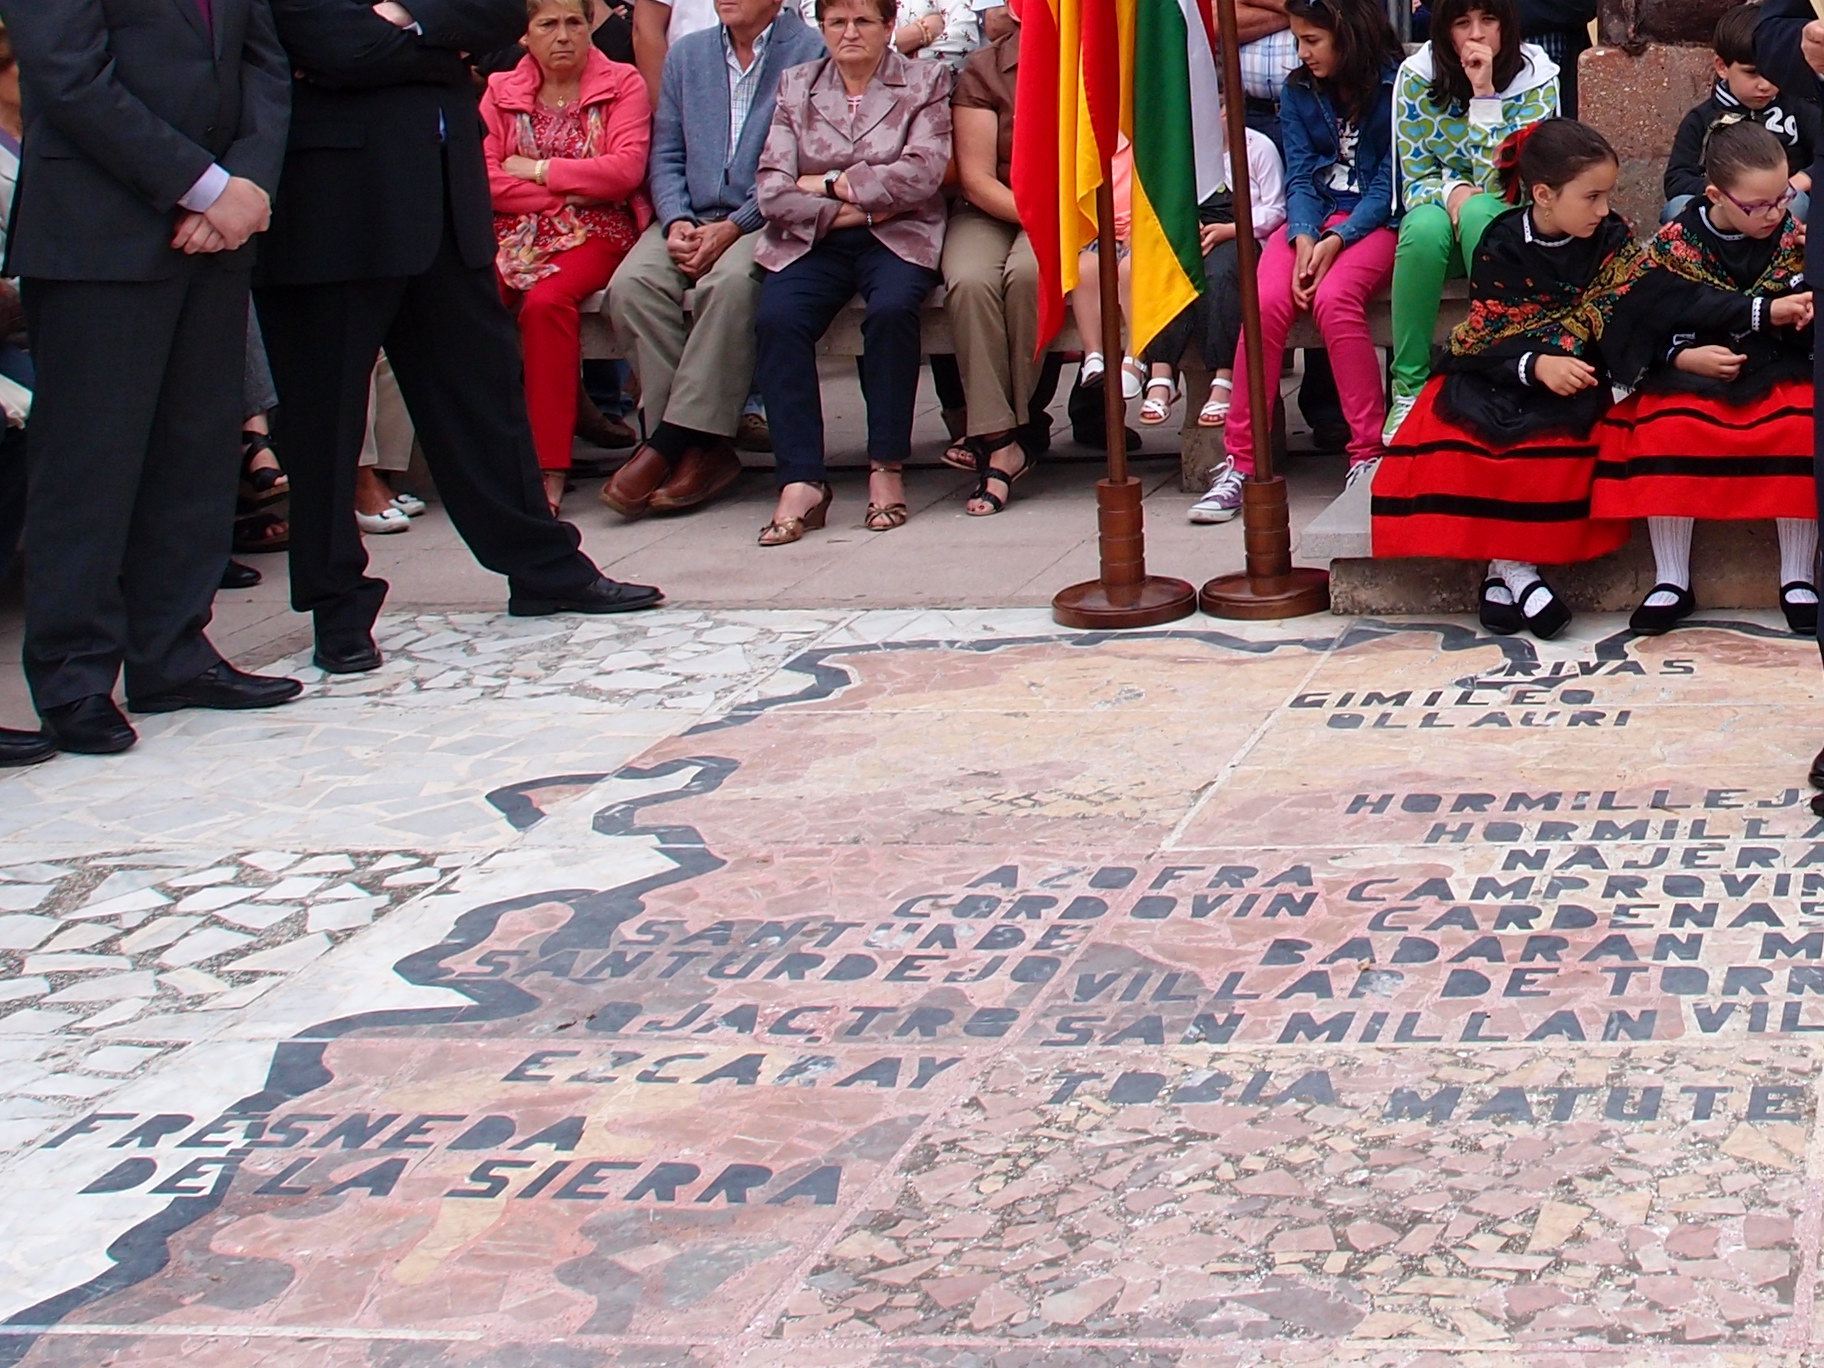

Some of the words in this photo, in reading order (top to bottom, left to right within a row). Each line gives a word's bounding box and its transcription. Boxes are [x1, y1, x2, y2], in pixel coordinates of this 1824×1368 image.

[1763, 106, 1799, 146] 29
[1502, 659, 1696, 677] RIVAS
[1289, 688, 1595, 708] GIMILEO
[1325, 710, 1633, 729] OLLAURI
[1346, 787, 1801, 815] HORMILLEJ
[965, 864, 1314, 890] AZOFRA
[892, 891, 1319, 920] CORDOVIN
[634, 918, 1091, 950] SANTURDE
[1258, 932, 1702, 967] BADARAN
[455, 949, 1062, 982] SANTURDEJO
[1074, 968, 1405, 1002] VILLAR
[1439, 966, 1557, 999] DE
[1040, 1012, 1246, 1047] SAN
[1276, 1008, 1658, 1044] MILLAN
[501, 1050, 968, 1088] EZCARAY
[1047, 1069, 1336, 1105] TOBIA
[1385, 1084, 1803, 1122] MATUTE
[41, 1113, 587, 1152] FRESNEDA
[77, 1157, 232, 1195] DE
[252, 1157, 407, 1198] LA
[444, 1159, 844, 1206] SIERRA
